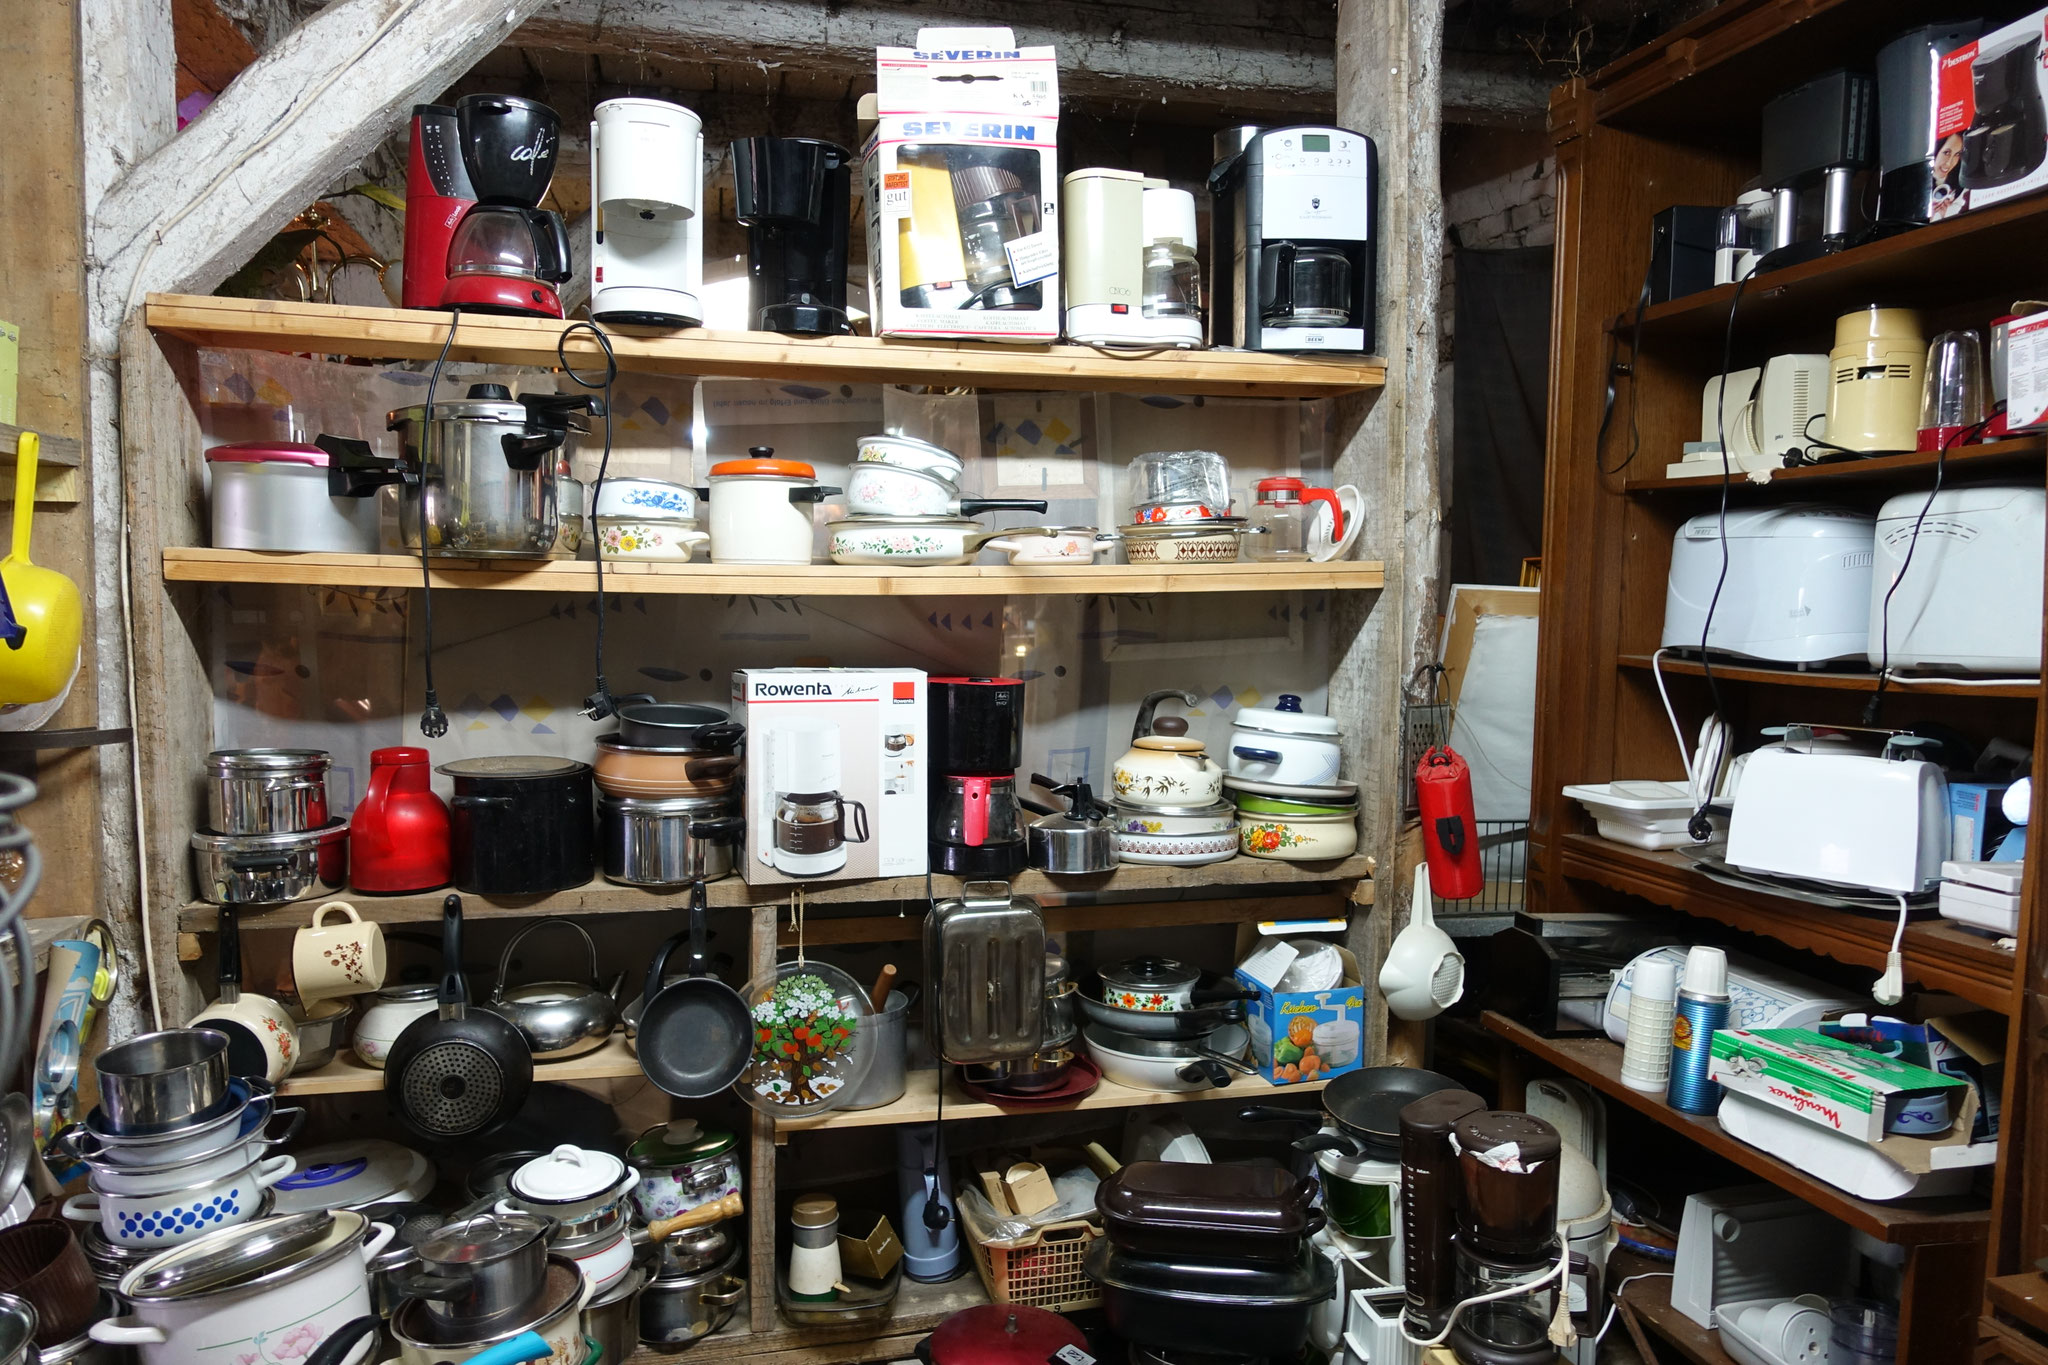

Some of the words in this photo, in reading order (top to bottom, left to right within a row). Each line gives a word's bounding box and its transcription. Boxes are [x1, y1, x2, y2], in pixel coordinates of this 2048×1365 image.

[913, 50, 1021, 61] SEVERIN
[903, 121, 1036, 141] SEVERIN
[886, 191, 908, 206] gut
[755, 682, 832, 697] Rowenta
[1767, 1085, 1842, 1129] Moulinex
